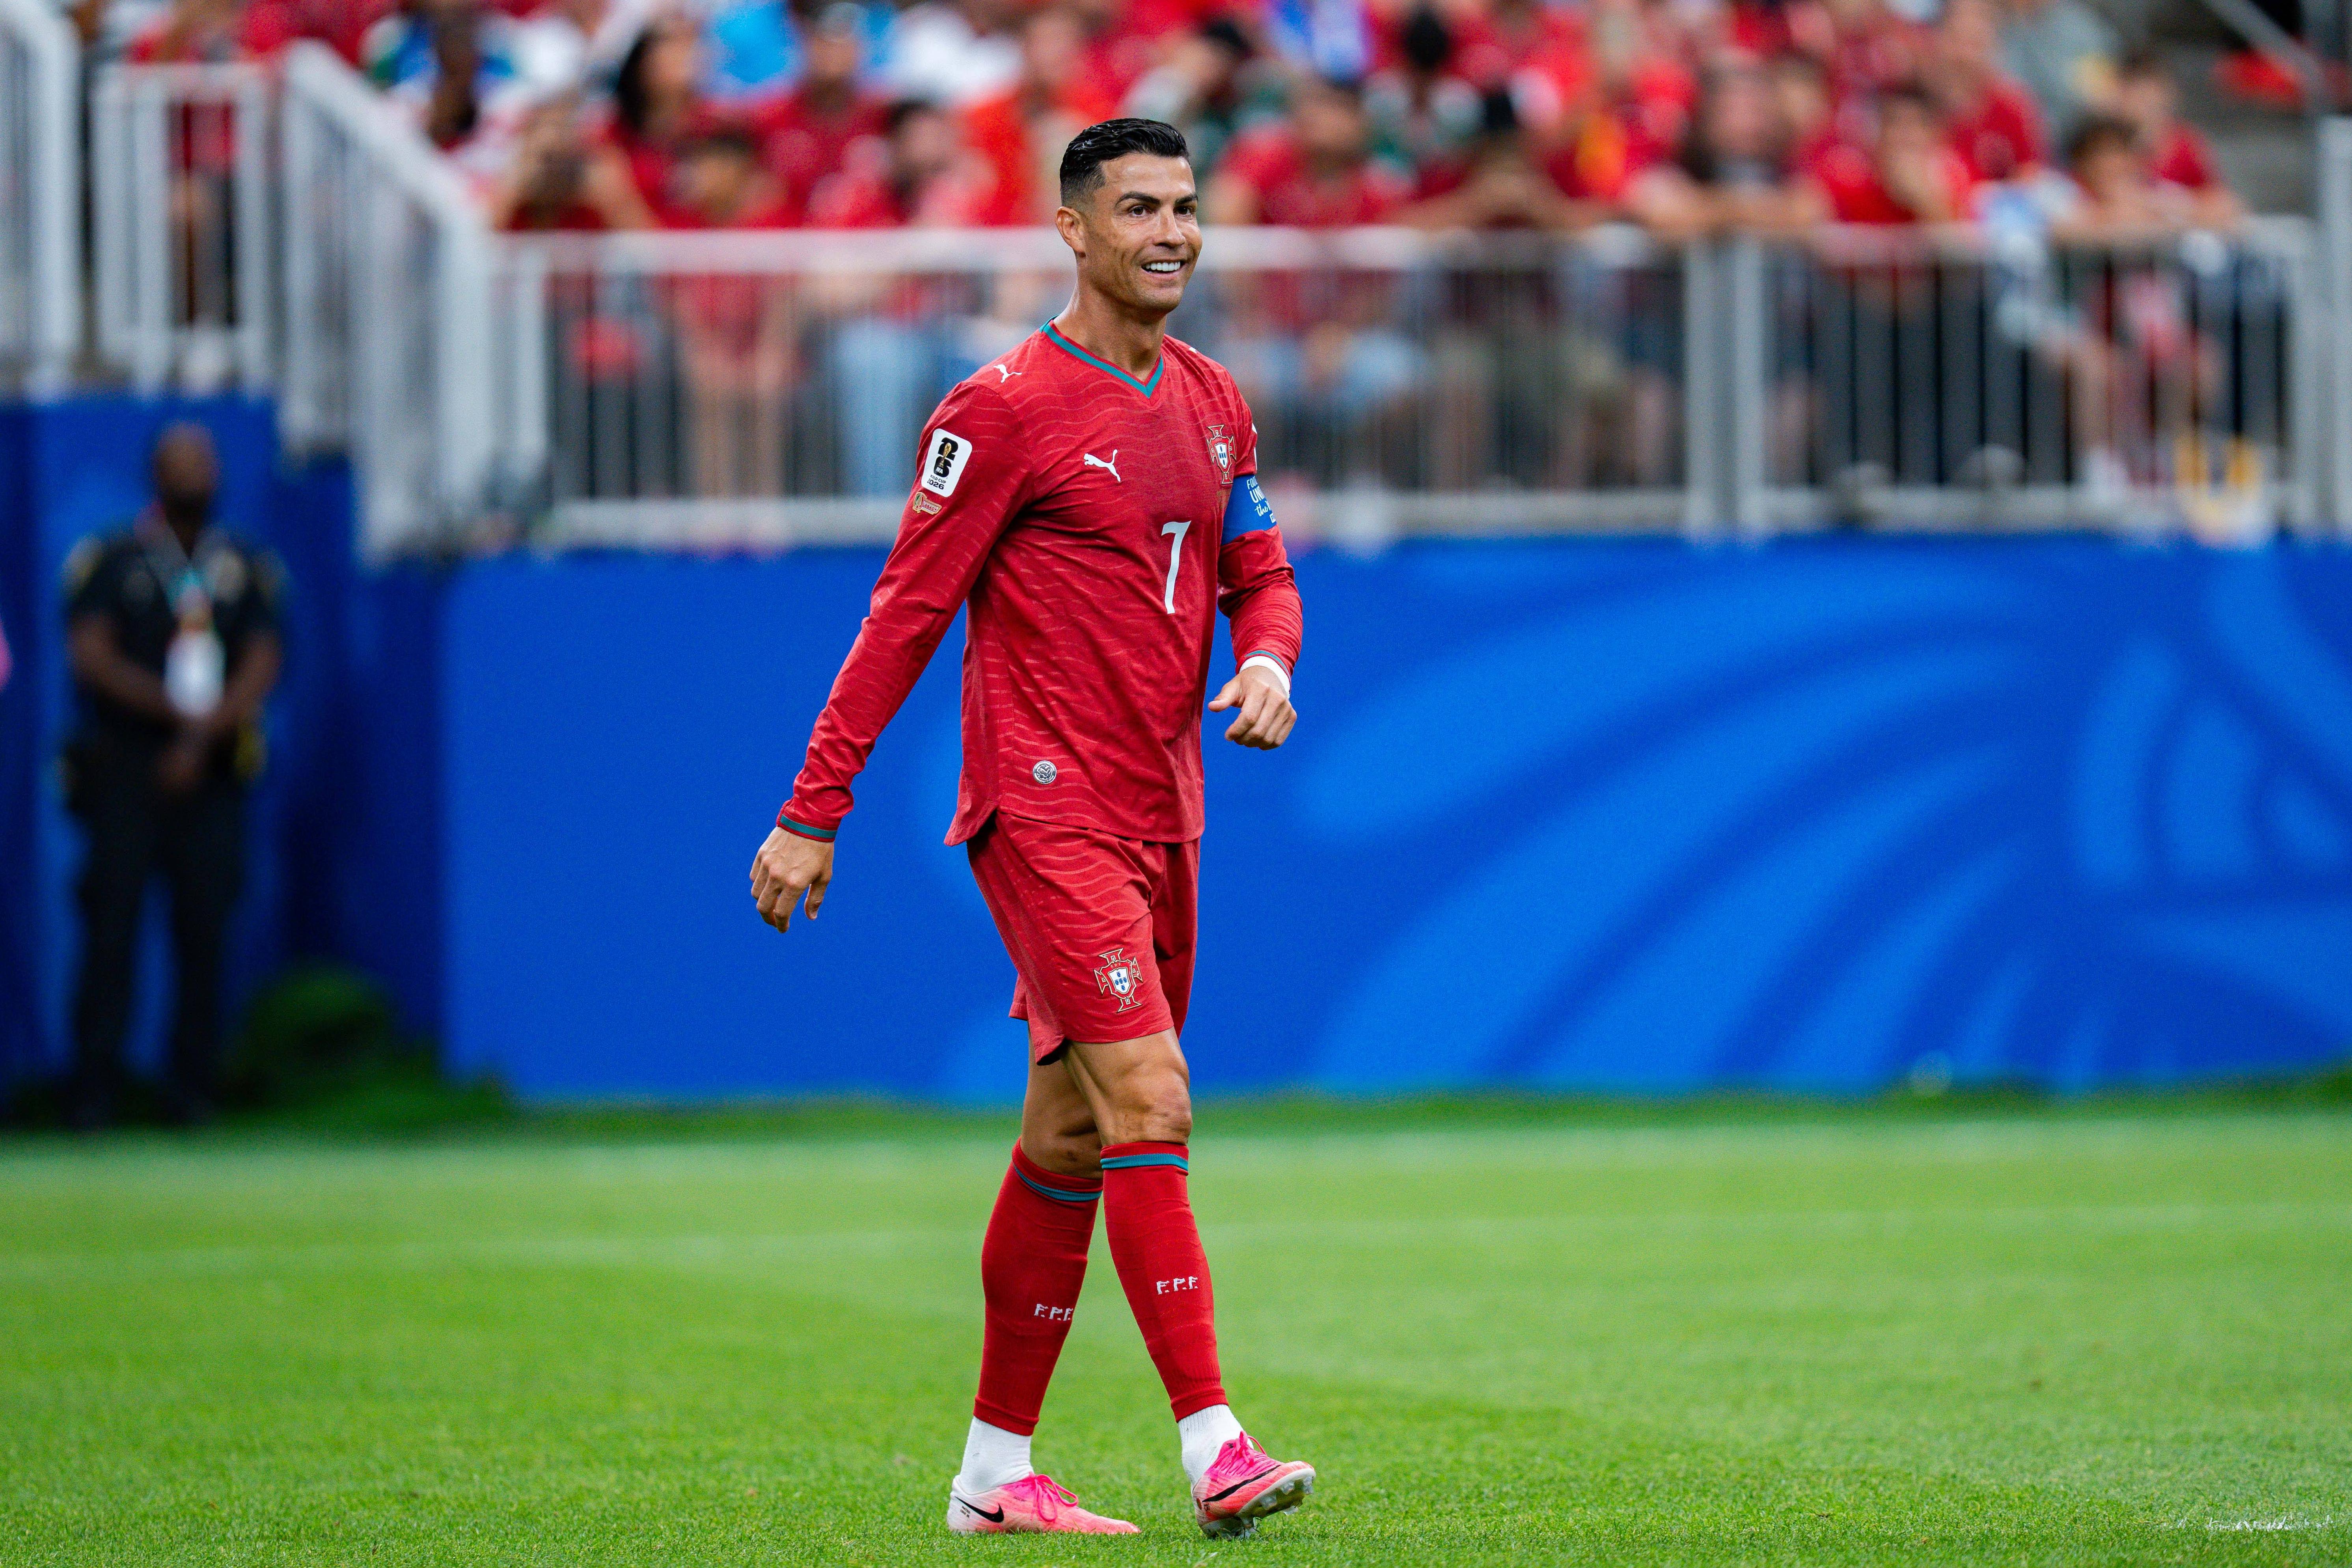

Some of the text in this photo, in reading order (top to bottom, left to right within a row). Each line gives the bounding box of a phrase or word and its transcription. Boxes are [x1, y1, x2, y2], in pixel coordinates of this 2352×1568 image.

[927, 478, 945, 490] 2026
[1254, 503, 1268, 517] the
[1161, 520, 1192, 614] 7
